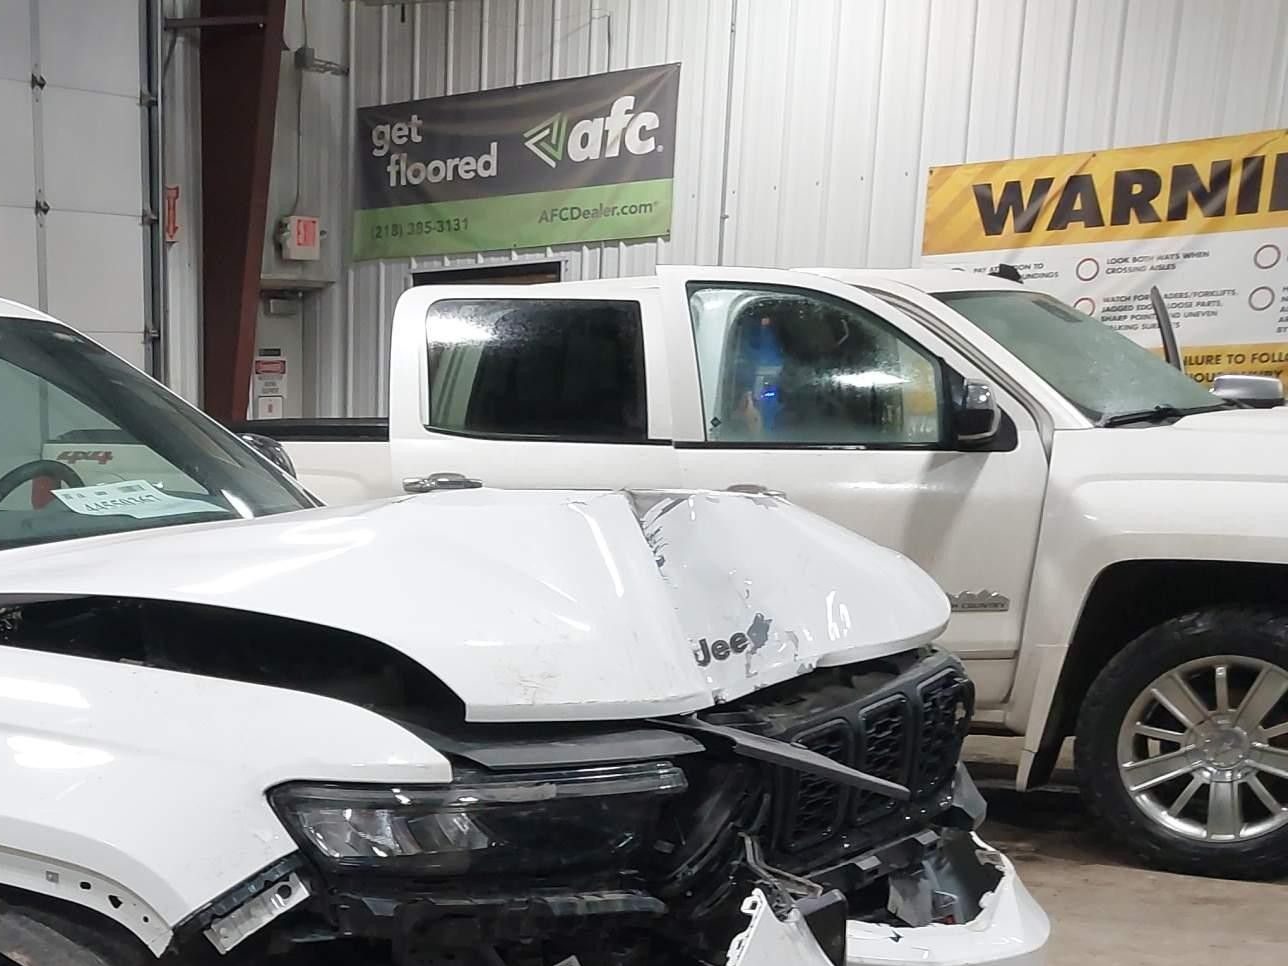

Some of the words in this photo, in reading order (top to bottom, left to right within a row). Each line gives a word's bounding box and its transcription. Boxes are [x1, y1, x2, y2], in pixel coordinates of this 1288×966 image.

[371, 114, 424, 156] get
[567, 95, 660, 162] afc
[387, 141, 498, 187] floored
[538, 202, 654, 224] AFCDealer.com
[370, 223, 404, 240] (218)
[1106, 256, 1129, 265] LOOK
[1132, 254, 1154, 263] BOTH
[1183, 250, 1210, 259] WHEN
[1105, 264, 1147, 275] CROSSING
[1149, 262, 1176, 271] AISLES
[1130, 312, 1158, 321] POINT
[1184, 354, 1222, 366] ILURE
[1227, 353, 1246, 365] TO
[693, 632, 750, 667] Jee
